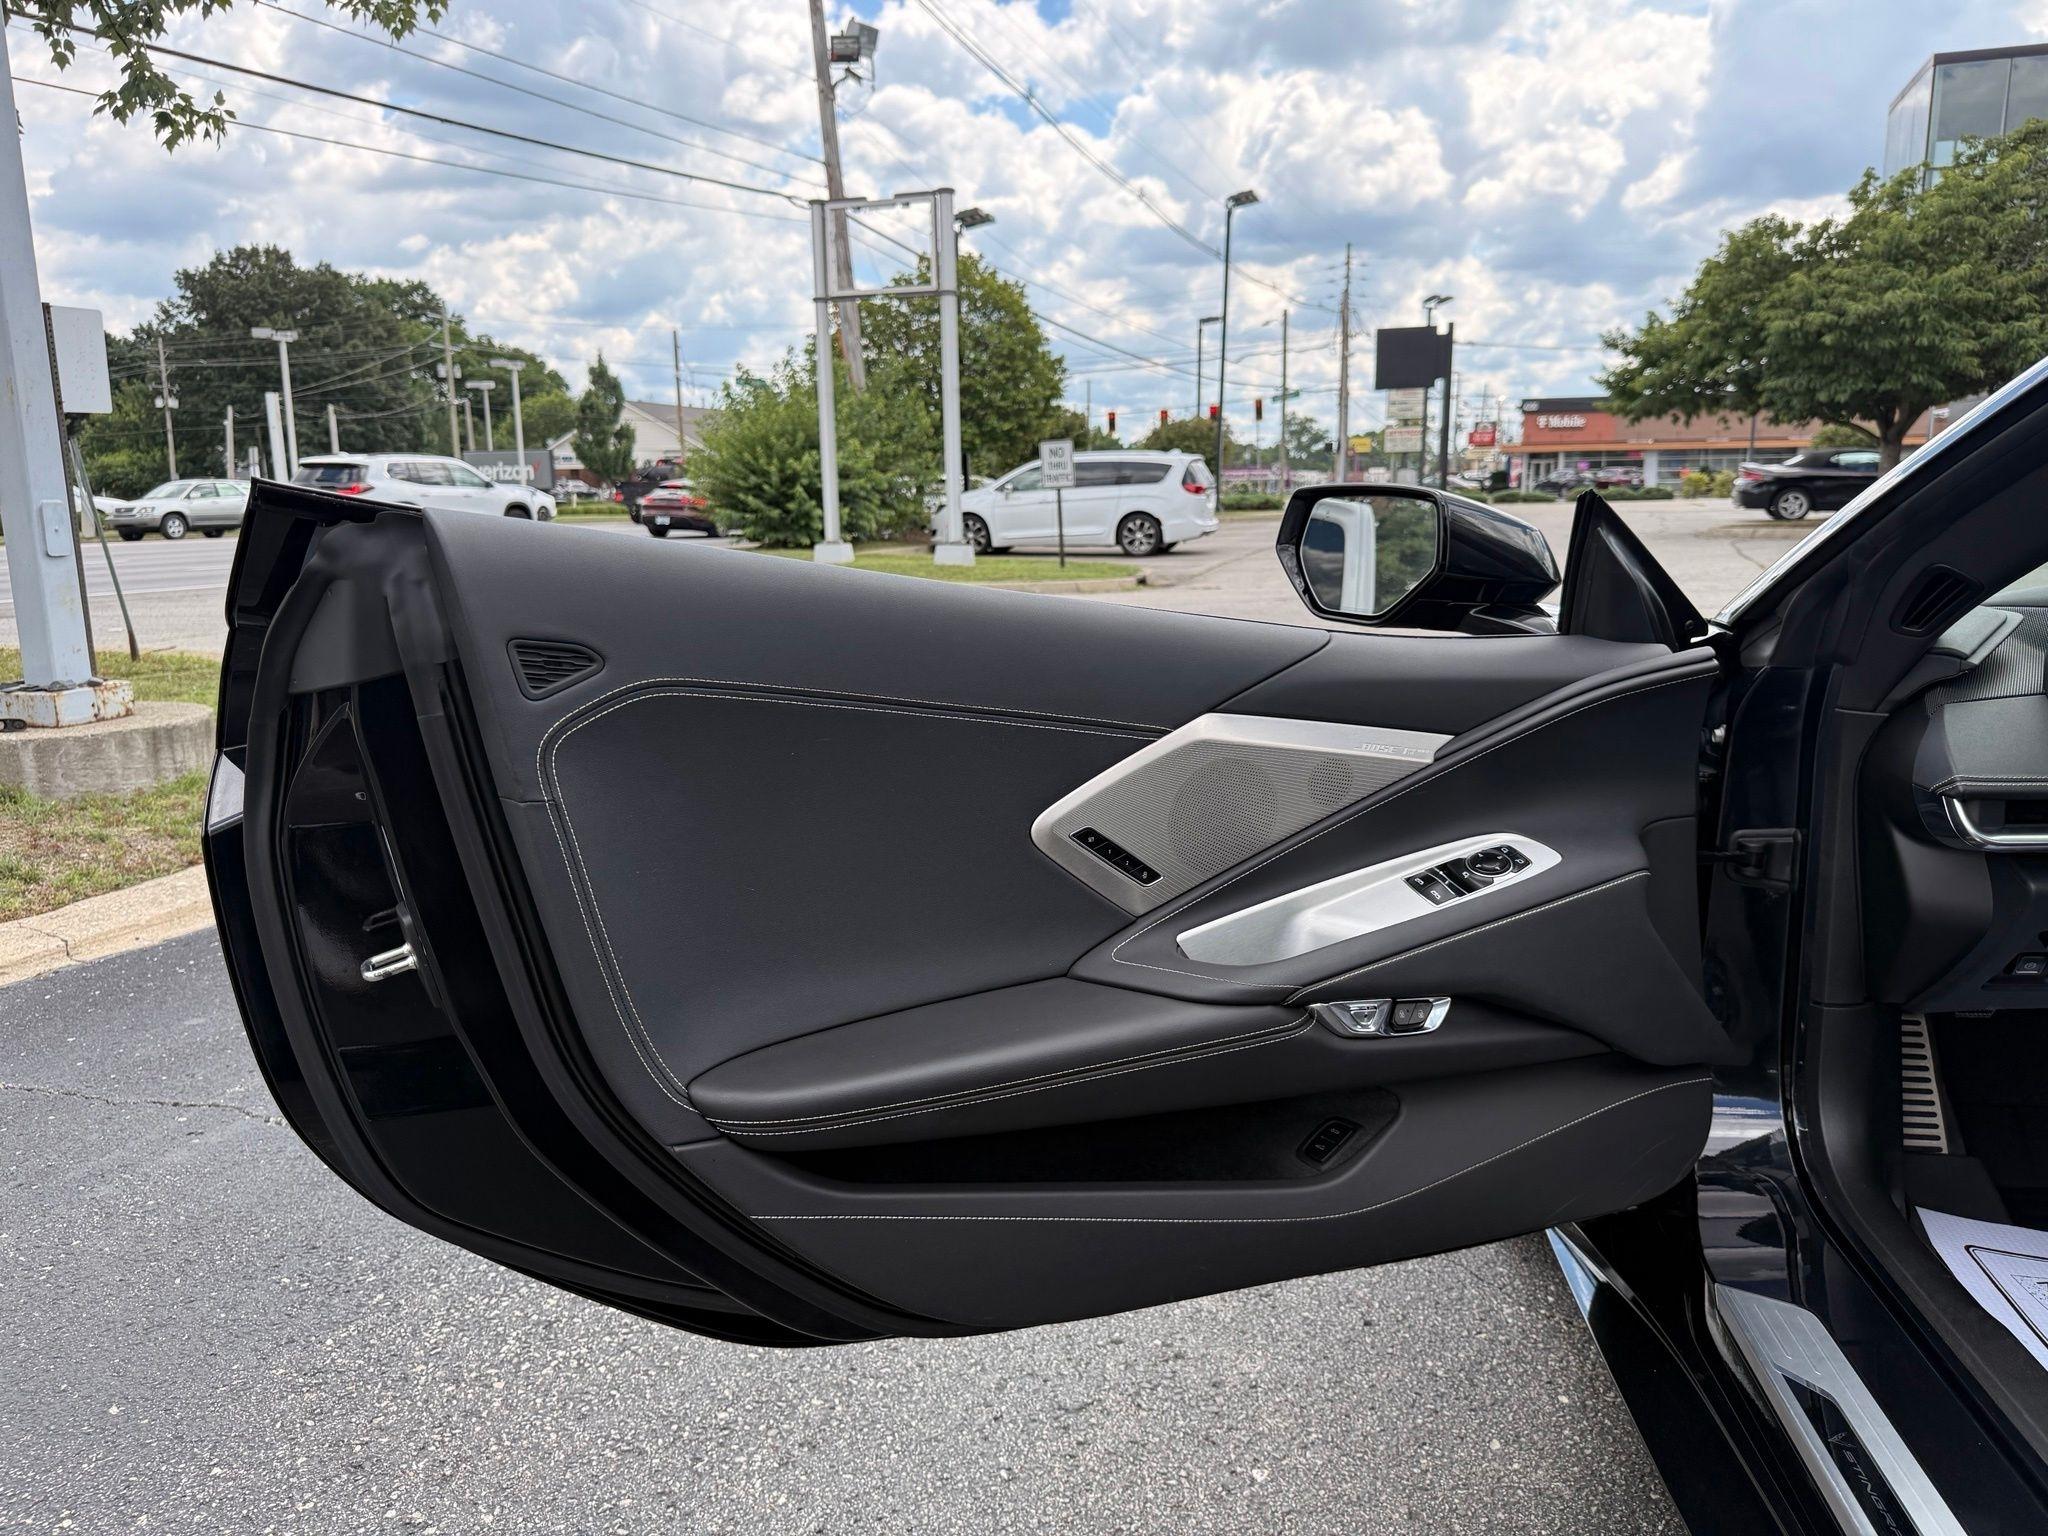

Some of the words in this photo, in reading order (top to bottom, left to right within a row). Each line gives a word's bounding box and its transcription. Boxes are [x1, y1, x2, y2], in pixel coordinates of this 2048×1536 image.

[1548, 415, 1587, 428] Mobile
[1048, 447, 1065, 458] NO
[1361, 743, 1403, 754] BOSE
